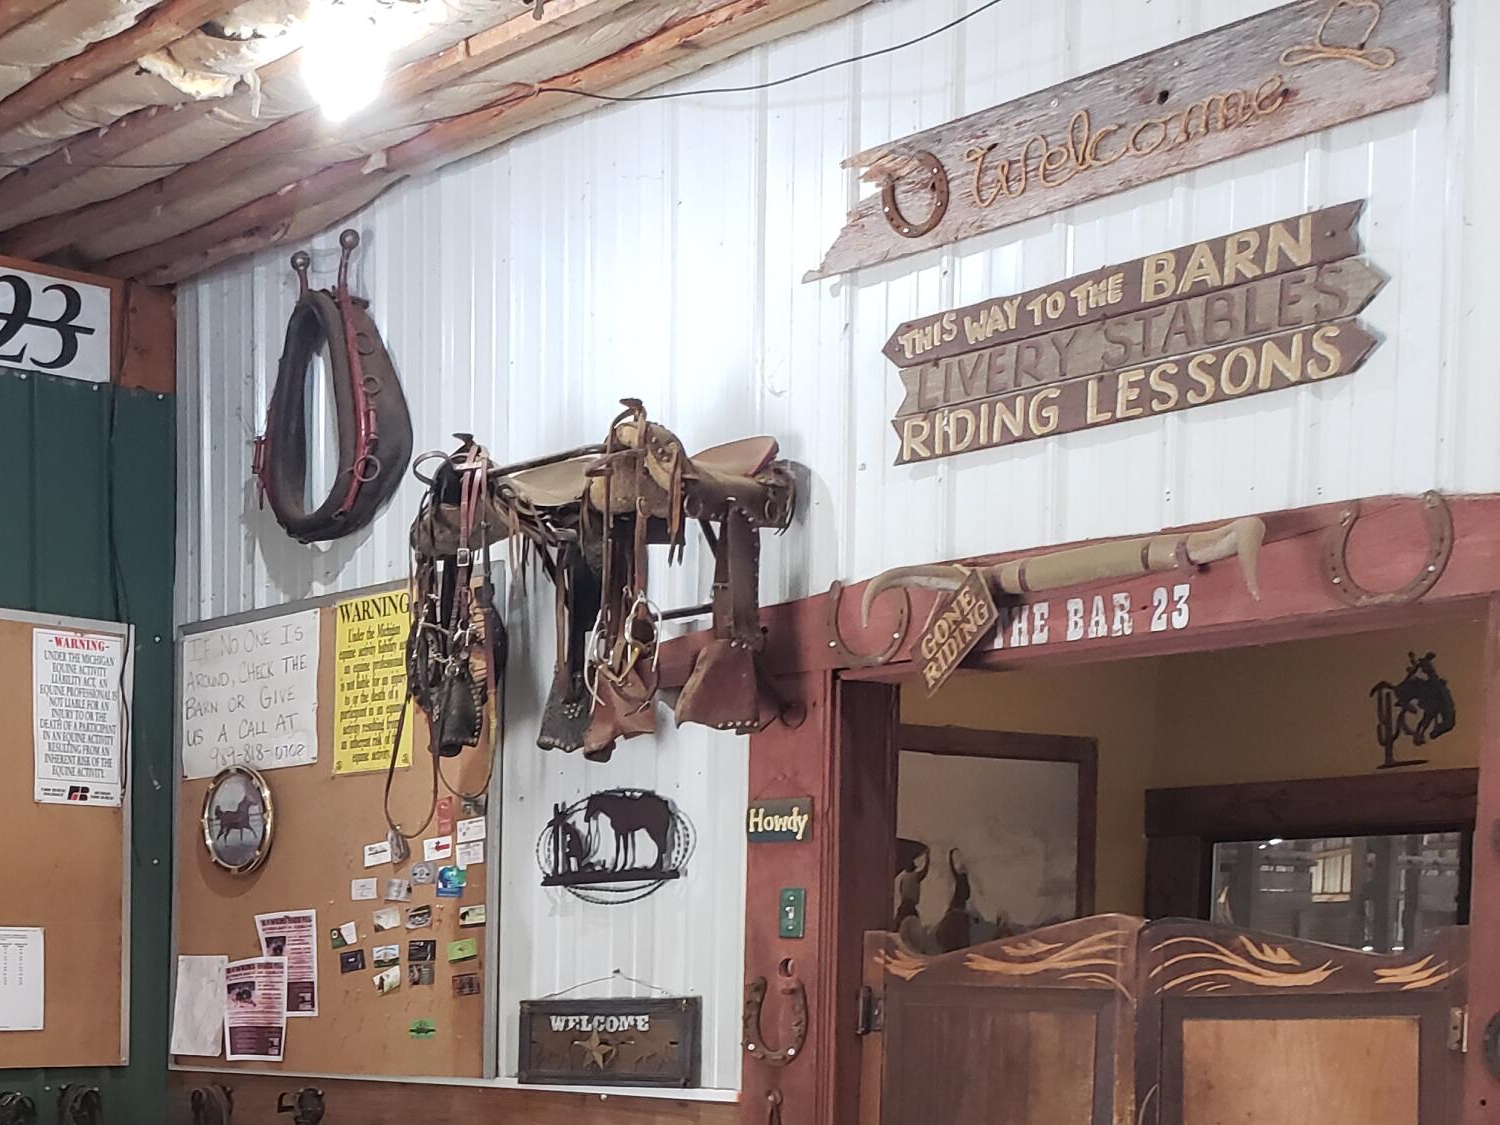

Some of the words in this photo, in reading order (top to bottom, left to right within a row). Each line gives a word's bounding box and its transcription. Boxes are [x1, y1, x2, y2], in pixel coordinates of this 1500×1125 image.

[964, 73, 1289, 208] Welcome
[899, 312, 957, 359] THIS
[963, 295, 1023, 344] WAY
[1026, 290, 1066, 326] TO
[1070, 272, 1125, 317] THE
[1140, 214, 1313, 303] BARN
[916, 328, 1078, 412] LIVERY
[1100, 265, 1350, 368] STABLES
[901, 386, 1062, 462] RIDING
[1085, 325, 1342, 425] LESSONS
[339, 592, 411, 624] WARNING
[920, 584, 976, 661] GONE
[1066, 592, 1133, 643] BAR
[1150, 583, 1192, 632] 23
[188, 636, 211, 662] IF
[220, 632, 238, 657] NO
[243, 629, 271, 653] ONE
[279, 623, 304, 646] IS
[922, 599, 990, 689] RIDING
[239, 661, 275, 684] CHECK
[281, 654, 308, 674] THE
[185, 697, 218, 721] BARN
[227, 694, 245, 713] OR
[259, 685, 296, 710] GIVE
[186, 729, 204, 747] US
[217, 723, 228, 743] A
[238, 718, 268, 740] CALL
[275, 712, 299, 732] AT
[749, 806, 809, 840] Howdy
[549, 1014, 650, 1033] WELCOME
